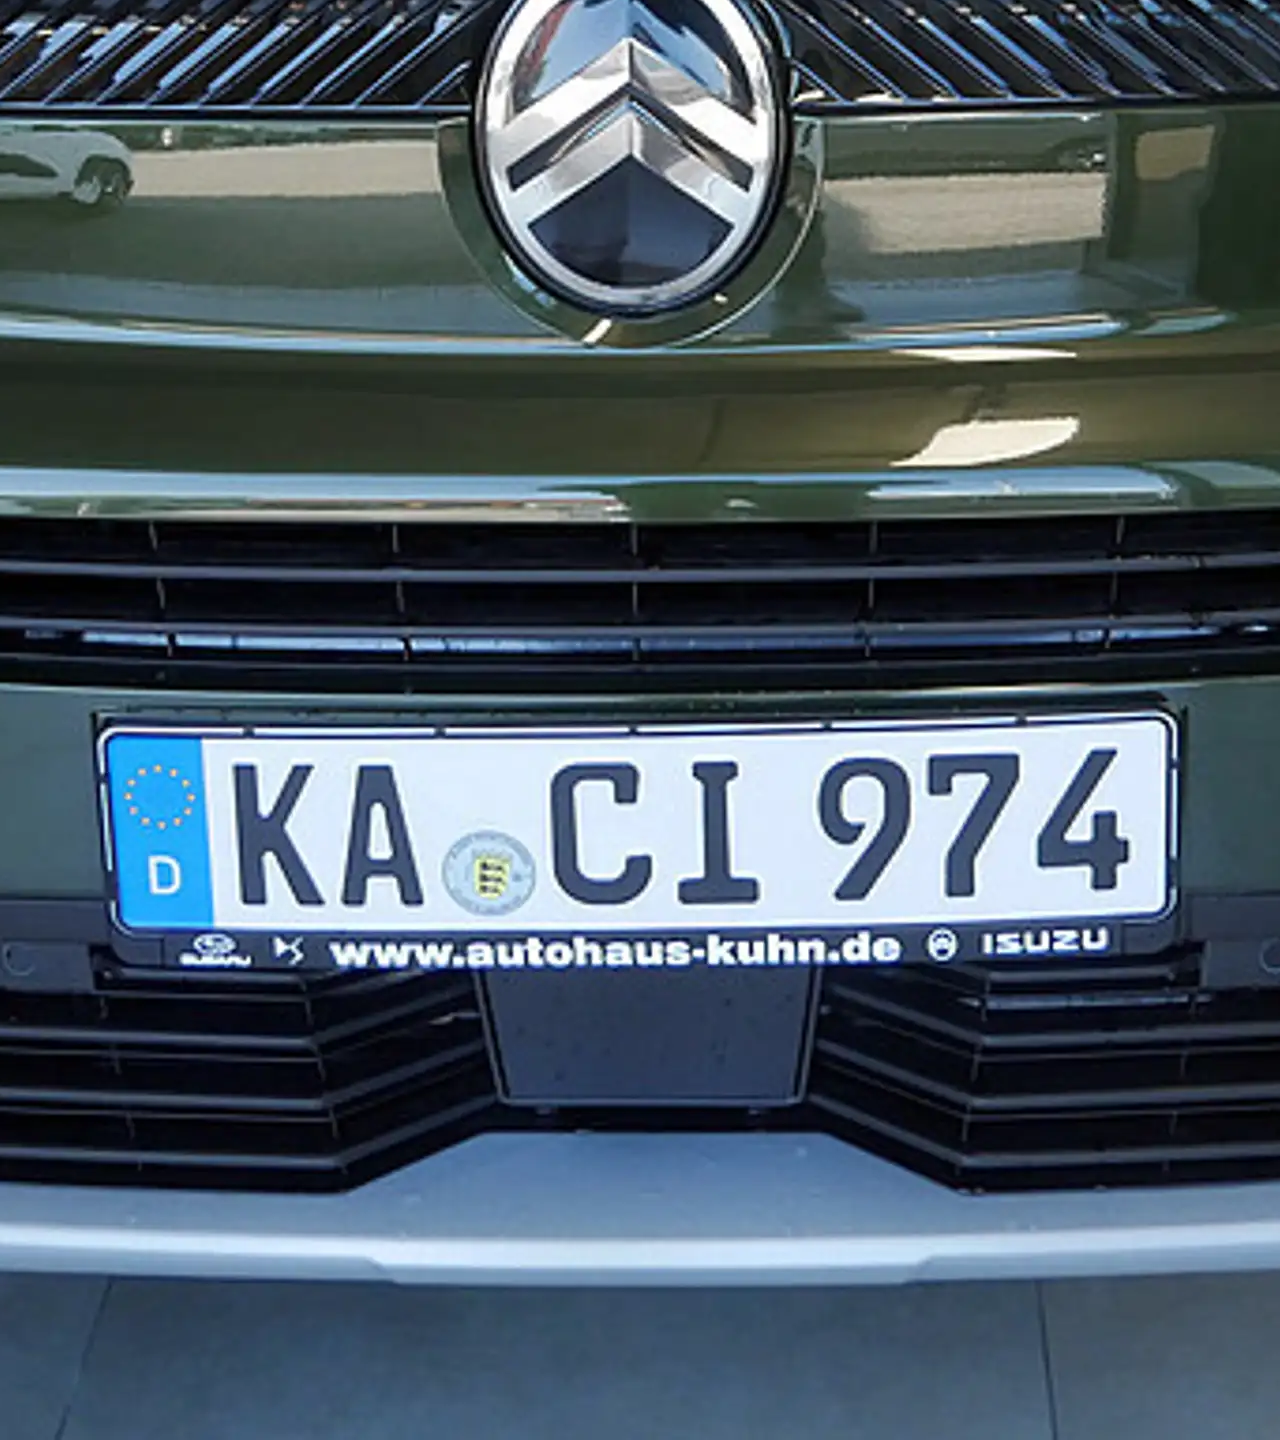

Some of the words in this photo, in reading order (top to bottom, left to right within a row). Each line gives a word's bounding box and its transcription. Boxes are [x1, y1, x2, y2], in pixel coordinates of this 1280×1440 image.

[231, 763, 425, 908] KA
[550, 760, 760, 906] CI
[817, 748, 1132, 902] 974
[148, 855, 182, 896] D
[329, 929, 901, 969] www.autohaus-kuhn.de
[982, 925, 1109, 956] ISUZU
